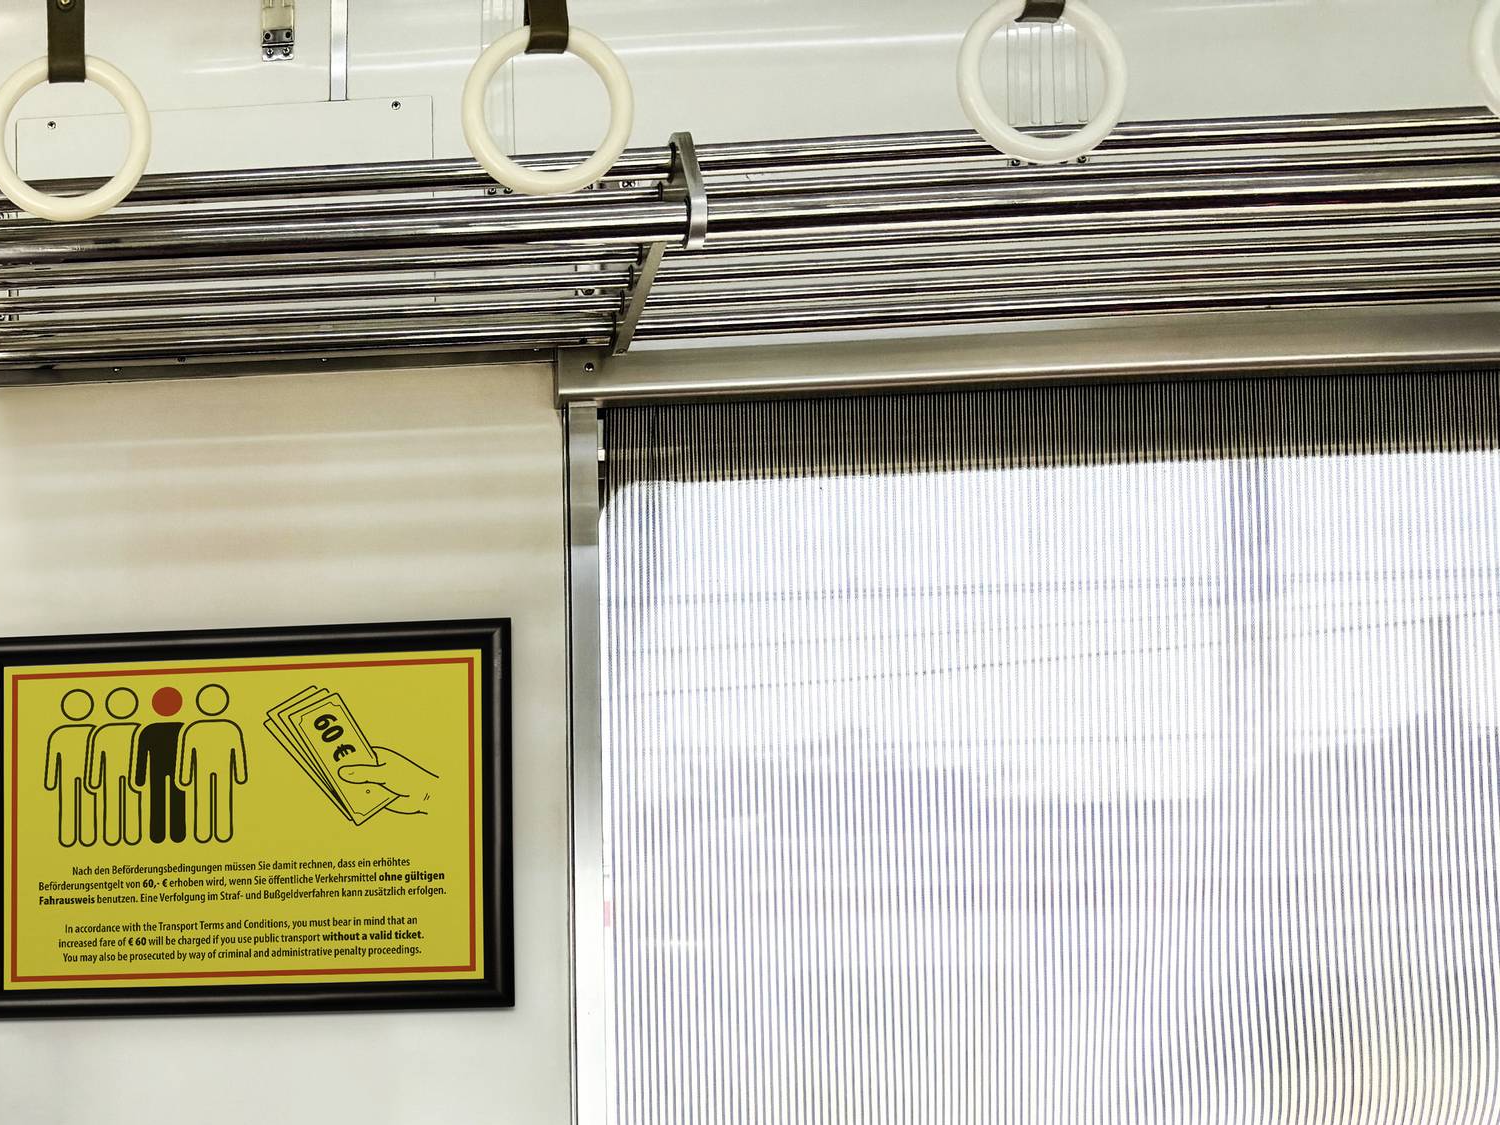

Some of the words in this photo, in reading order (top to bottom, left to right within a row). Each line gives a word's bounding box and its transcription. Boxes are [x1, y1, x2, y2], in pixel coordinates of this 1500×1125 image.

[313, 713, 344, 743] 60
[333, 743, 356, 763] €
[72, 865, 93, 876] Nach
[93, 865, 110, 876] den
[111, 863, 223, 876] Beförderungsbedingungen
[224, 861, 256, 872] müssen
[257, 860, 271, 871] Sie
[272, 859, 298, 870] damit
[298, 859, 336, 870] rechnen,
[337, 858, 356, 869] dass
[357, 858, 371, 868] ein
[372, 856, 411, 868] erhöhtes
[38, 879, 124, 893] Beförderungsentgelt
[125, 881, 141, 889] von
[142, 878, 160, 889] 60,-
[161, 878, 168, 888] €
[168, 877, 204, 888] erhoben
[205, 876, 227, 887] wird,
[228, 878, 252, 886] wenn
[253, 875, 267, 885] Sie
[267, 873, 314, 885] öffentliche
[314, 871, 377, 884] Verkehrsmittel
[378, 871, 403, 882] ohne
[404, 870, 445, 884] gültigen
[39, 894, 96, 906] Fahrausweis
[96, 894, 139, 904] benutzen.
[140, 893, 159, 903] Eine
[159, 891, 206, 904] Verfolgung
[207, 891, 219, 901] im
[219, 890, 244, 901] Straf-
[245, 889, 262, 900] und
[263, 888, 340, 902] Bußgeldverfahren
[341, 887, 363, 897] kann
[364, 885, 406, 897] zusätzlich
[407, 885, 447, 898] erfolgen.
[64, 923, 73, 934] In
[74, 923, 121, 934] accordance
[121, 921, 141, 932] with
[142, 921, 157, 932] the
[157, 921, 198, 933] Transport
[199, 920, 225, 930] Terms
[225, 919, 242, 930] and
[243, 918, 291, 929] Conditions,
[291, 920, 308, 930] you
[308, 918, 331, 927] must
[332, 916, 352, 927] bear
[352, 916, 362, 926] in
[363, 915, 386, 926] mind
[386, 915, 405, 926] that
[406, 917, 418, 925] an
[58, 937, 98, 948] increased
[98, 937, 116, 947] fare
[117, 936, 127, 947] of
[127, 936, 134, 947] €
[134, 936, 147, 946] 60
[148, 935, 164, 946] will
[165, 935, 177, 946] be
[177, 934, 211, 947] charged
[212, 934, 220, 944] if
[220, 936, 236, 947] you
[237, 936, 253, 944] use
[253, 932, 280, 946] public
[280, 933, 321, 944] transport
[322, 931, 360, 942] without
[361, 933, 368, 941] a
[369, 929, 393, 940] valid
[394, 929, 425, 940] ticket.
[62, 952, 78, 963] You
[79, 954, 98, 964] may
[98, 951, 116, 962] also
[117, 951, 128, 961] be
[129, 949, 176, 963] prosecuted
[176, 949, 188, 962] by
[188, 951, 206, 962] way
[207, 948, 217, 959] of
[217, 948, 252, 959] criminal
[253, 947, 270, 958] and
[271, 946, 333, 958] administrative
[333, 945, 367, 958] penalty
[368, 944, 422, 958] proceedings.
